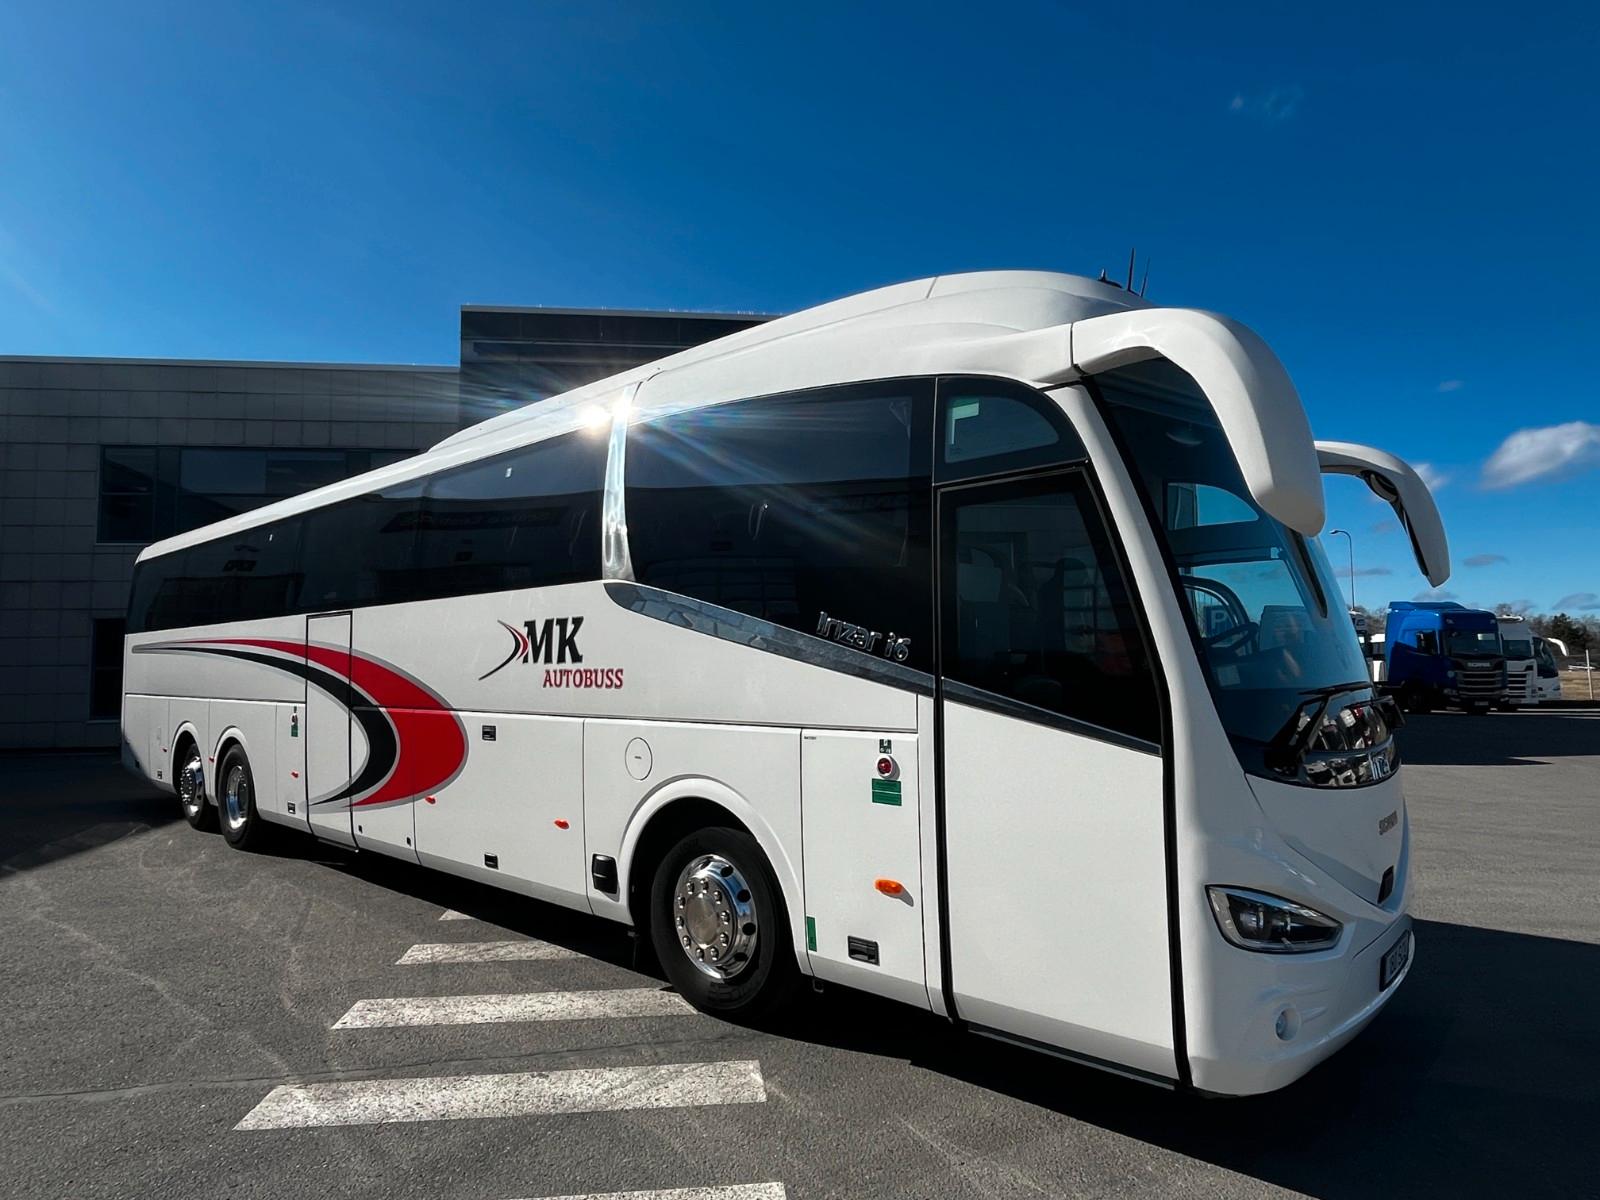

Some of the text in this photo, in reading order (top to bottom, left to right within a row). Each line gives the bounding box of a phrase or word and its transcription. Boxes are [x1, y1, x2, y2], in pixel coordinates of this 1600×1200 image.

[1211, 610, 1228, 629] P
[522, 616, 584, 664] MK
[543, 668, 624, 689] AUTOBUSS
